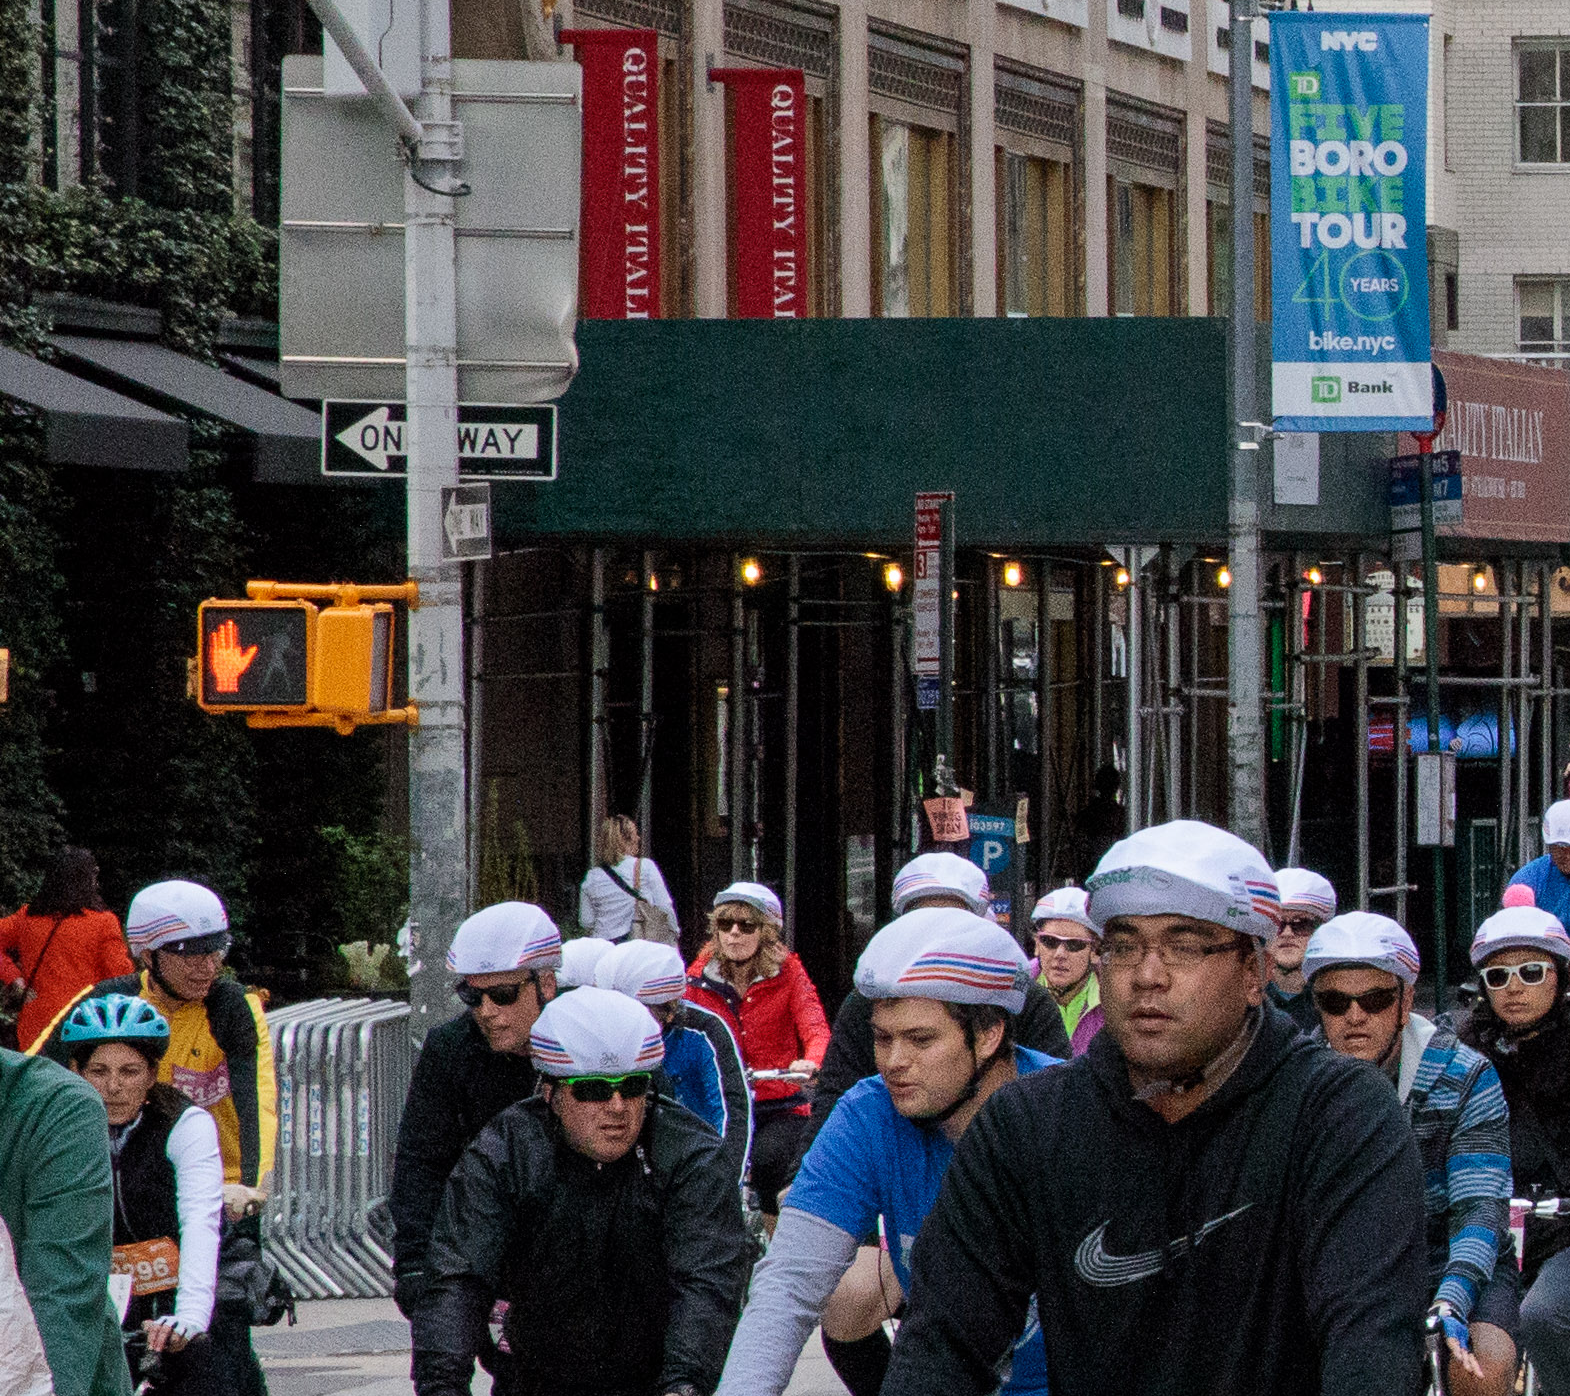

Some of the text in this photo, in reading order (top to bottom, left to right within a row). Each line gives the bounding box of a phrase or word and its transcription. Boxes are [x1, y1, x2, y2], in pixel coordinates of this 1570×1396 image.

[1321, 30, 1378, 52] NYC
[625, 47, 650, 207] QUALITY
[1289, 105, 1405, 141] FIVE
[772, 85, 797, 236] QUALITY
[1290, 140, 1408, 177] BORO
[1290, 176, 1404, 213] BIKE
[1291, 212, 1407, 251] TOUR
[1351, 277, 1399, 294] YEARS
[1309, 330, 1396, 354] bike.nyc
[1348, 379, 1394, 396] Bank
[360, 420, 405, 452] ON
[982, 839, 1004, 871] P
